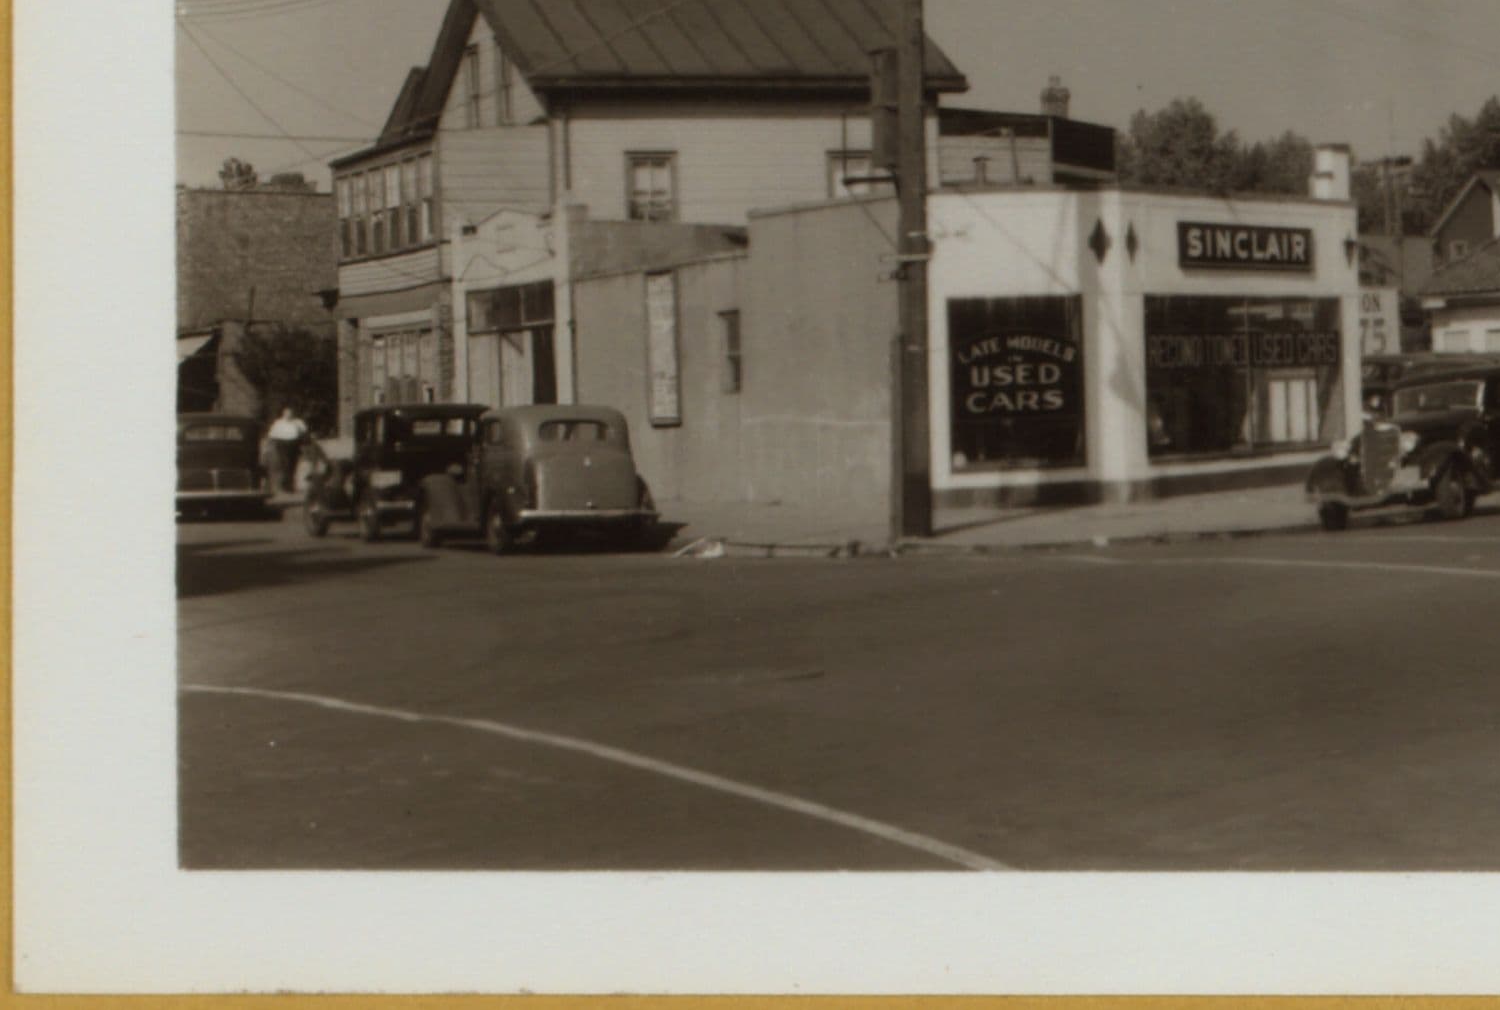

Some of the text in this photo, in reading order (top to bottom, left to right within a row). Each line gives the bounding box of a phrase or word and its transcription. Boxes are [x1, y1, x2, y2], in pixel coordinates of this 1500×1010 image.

[1186, 226, 1306, 262] SINCLAIR
[957, 335, 1077, 364] LATE MODELS
[1249, 333, 1294, 365] USED
[1297, 333, 1338, 364] CARS
[970, 362, 1062, 389] USED
[965, 388, 1065, 414] CARS
